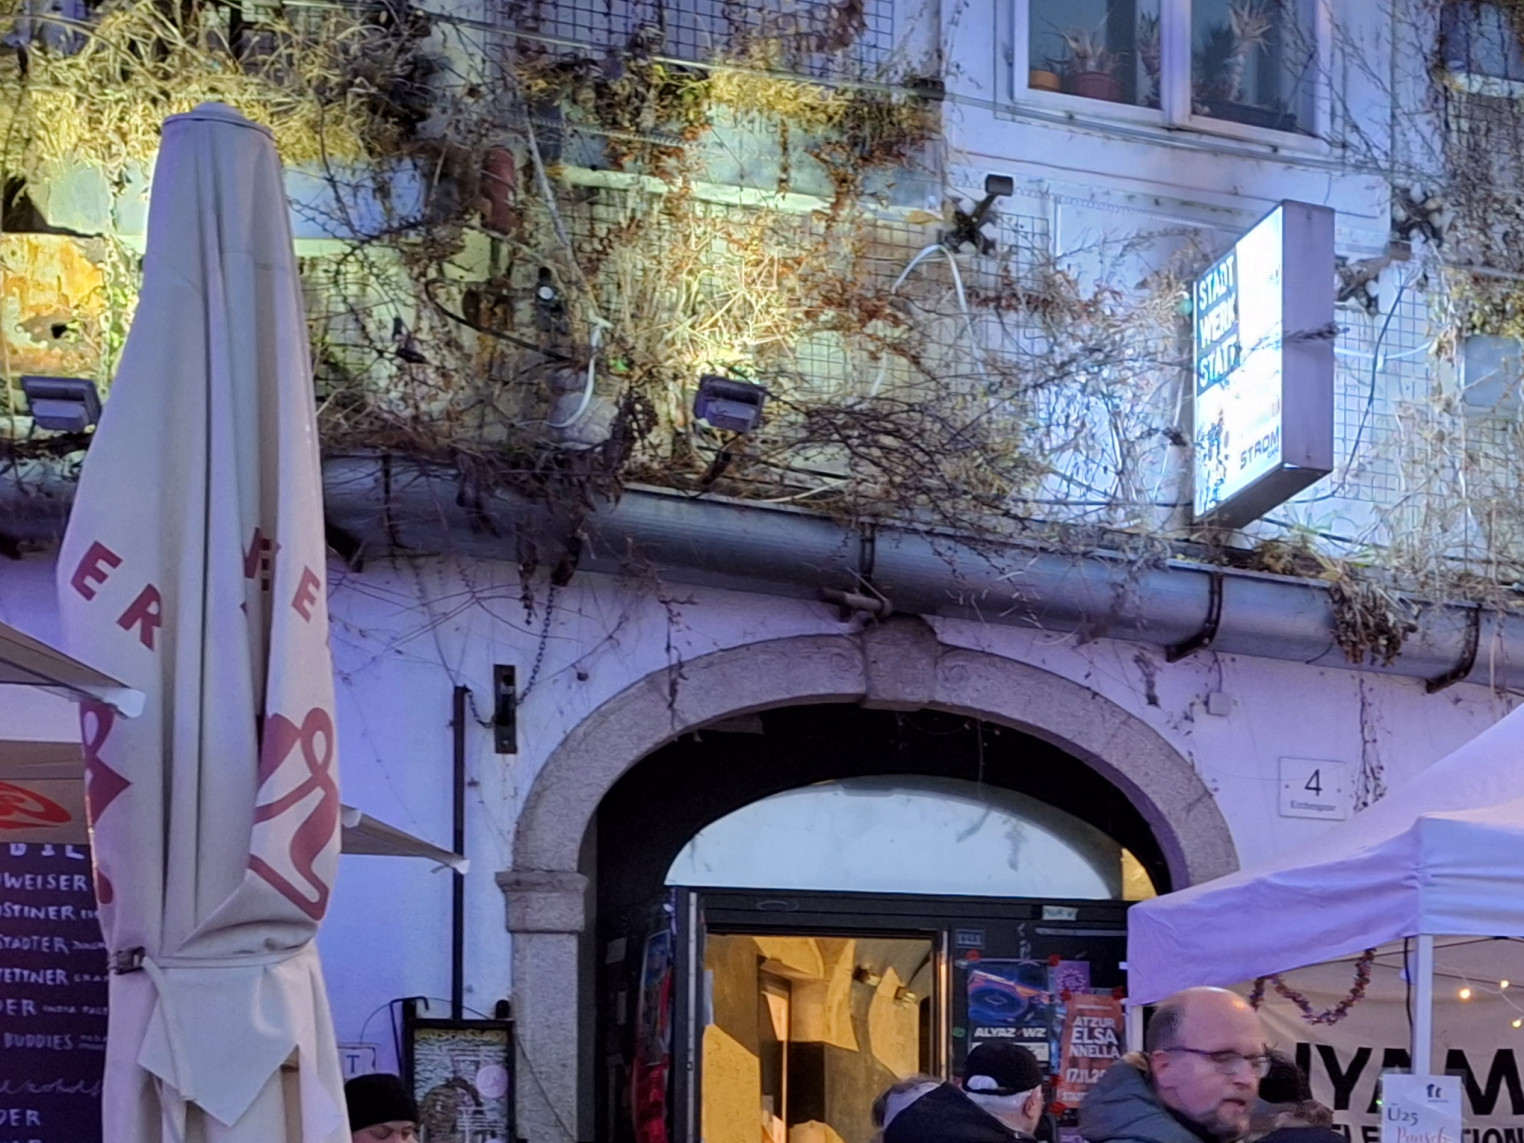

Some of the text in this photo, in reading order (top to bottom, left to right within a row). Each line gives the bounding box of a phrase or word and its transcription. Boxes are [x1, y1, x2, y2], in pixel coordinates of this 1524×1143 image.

[1304, 768, 1323, 797] 4
[0, 872, 87, 892] WEISER
[0, 902, 76, 920] STINER
[1071, 1027, 1119, 1045] ELSA
